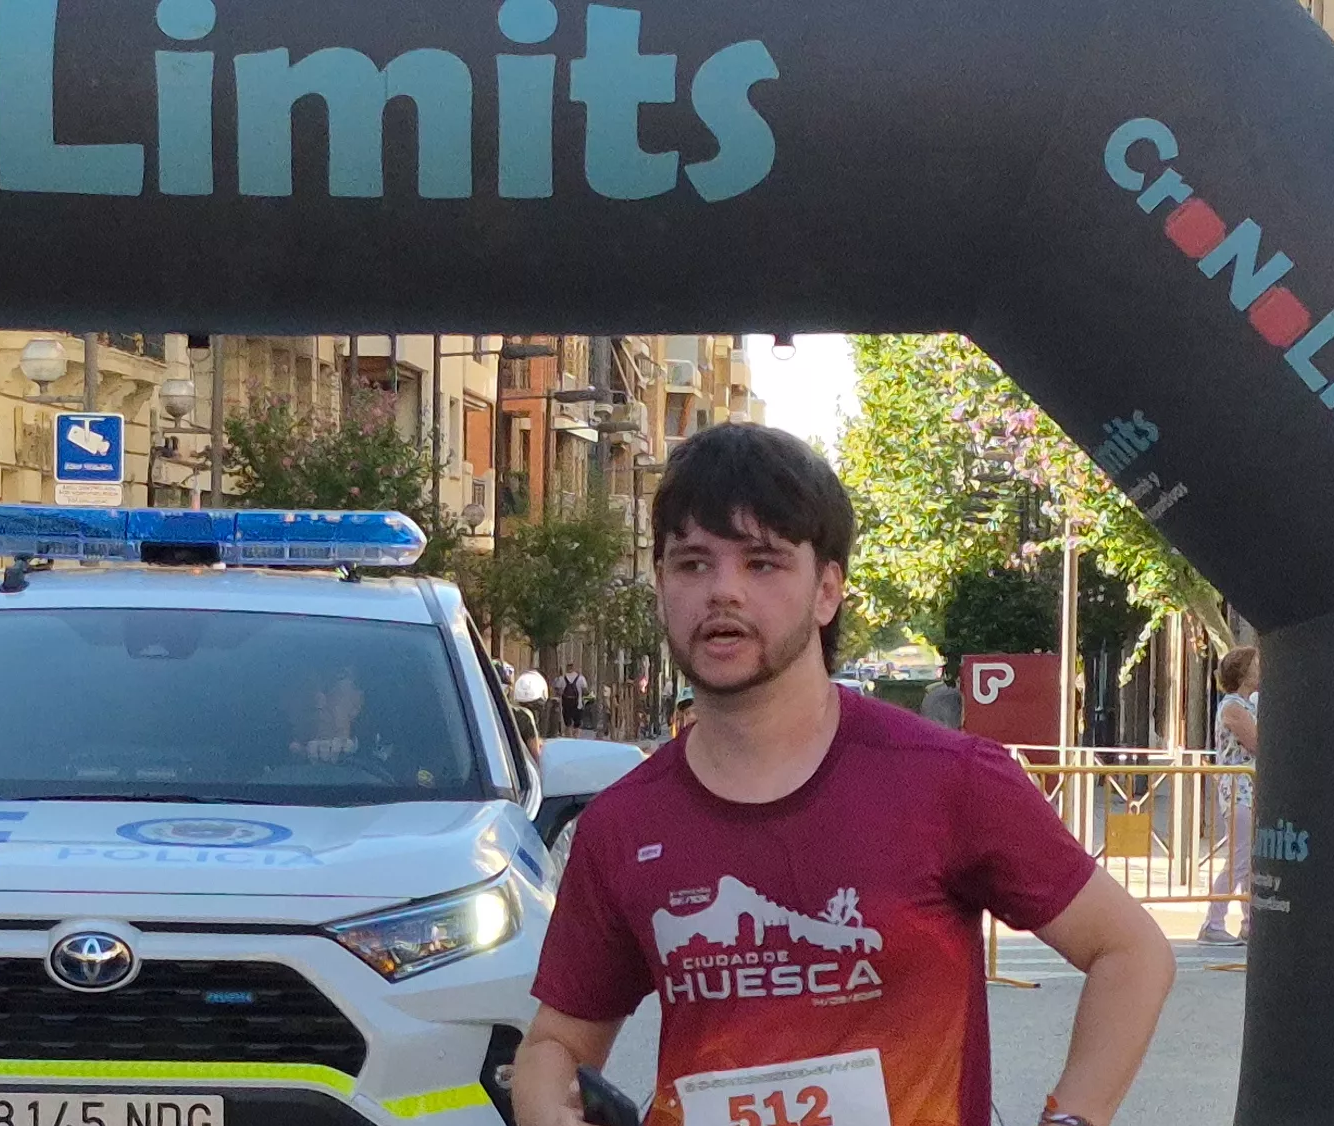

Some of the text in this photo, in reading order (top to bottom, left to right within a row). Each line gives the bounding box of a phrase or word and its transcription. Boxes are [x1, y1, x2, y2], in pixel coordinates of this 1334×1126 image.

[683, 951, 789, 970] CIUDAD DE
[665, 960, 883, 1004] HUESCA
